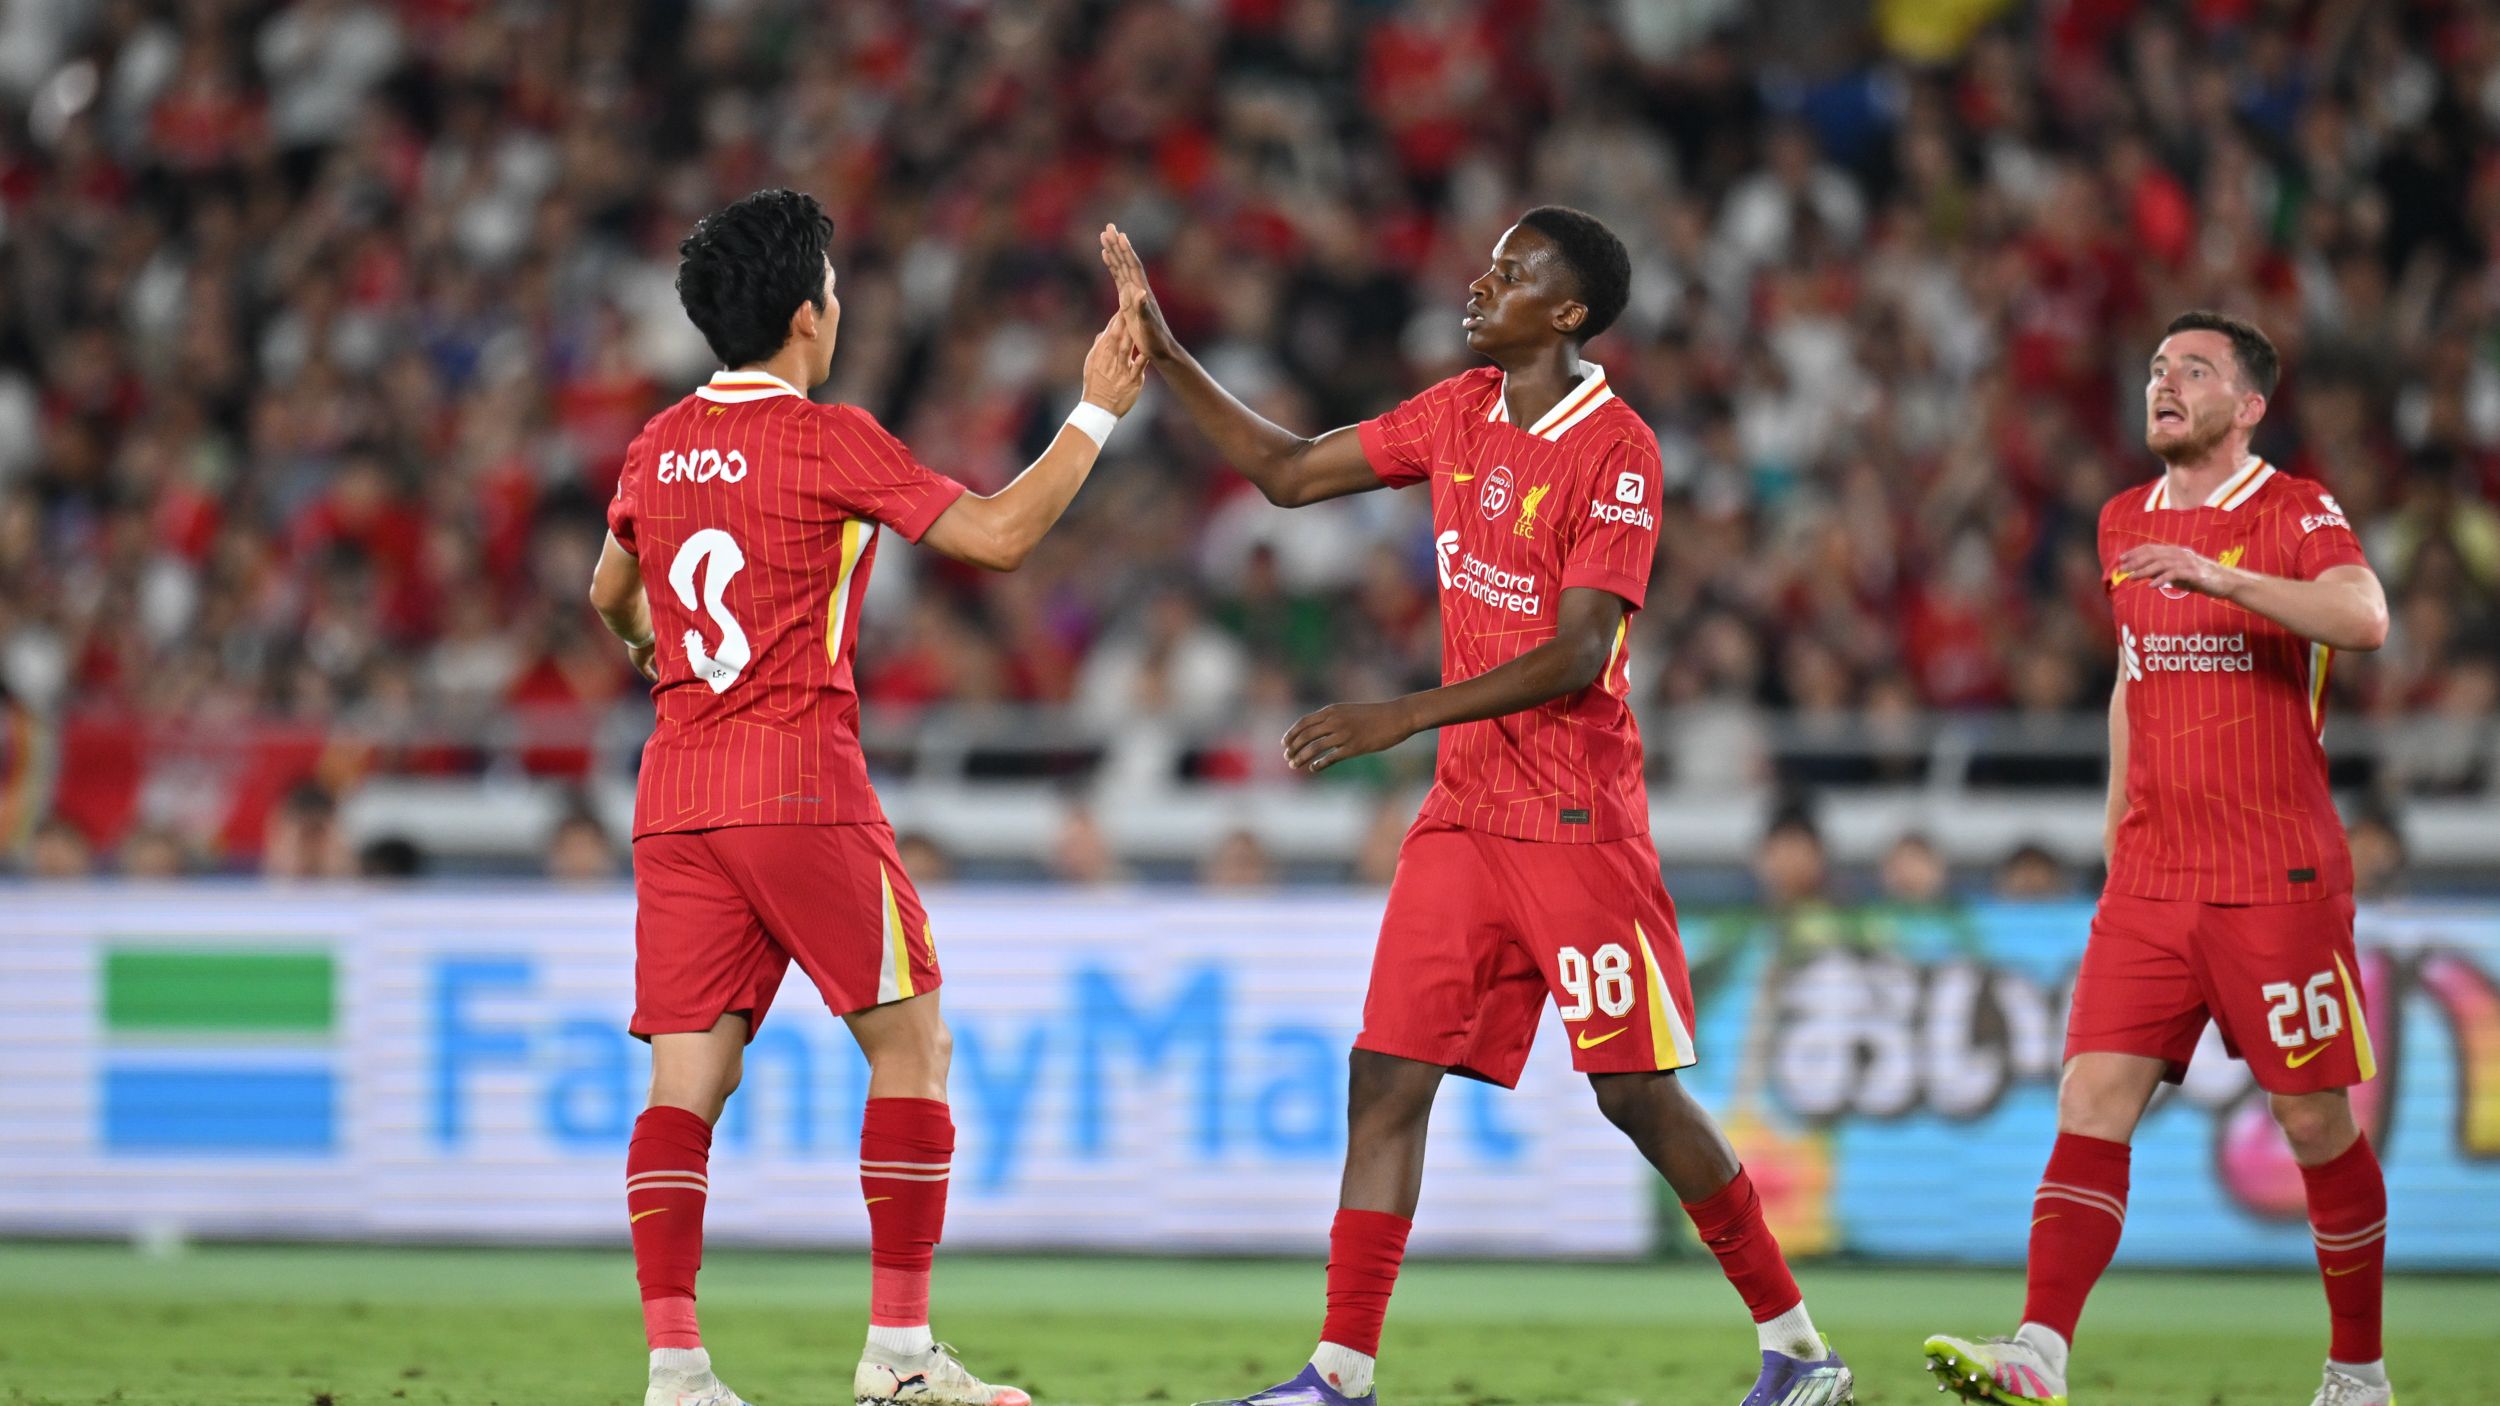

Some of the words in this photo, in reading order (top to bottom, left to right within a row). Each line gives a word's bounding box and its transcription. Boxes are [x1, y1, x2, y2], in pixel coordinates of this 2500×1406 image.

[657, 449, 747, 484] ENDO
[1482, 485, 1505, 510] 20
[1462, 552, 1535, 594] standard
[1453, 573, 1539, 616] chartered
[2143, 632, 2244, 653] standard
[2145, 652, 2253, 672] chartered
[1557, 943, 1635, 1021] 98
[2261, 970, 2343, 1048] 26
[430, 955, 1527, 1193] FamyMa
